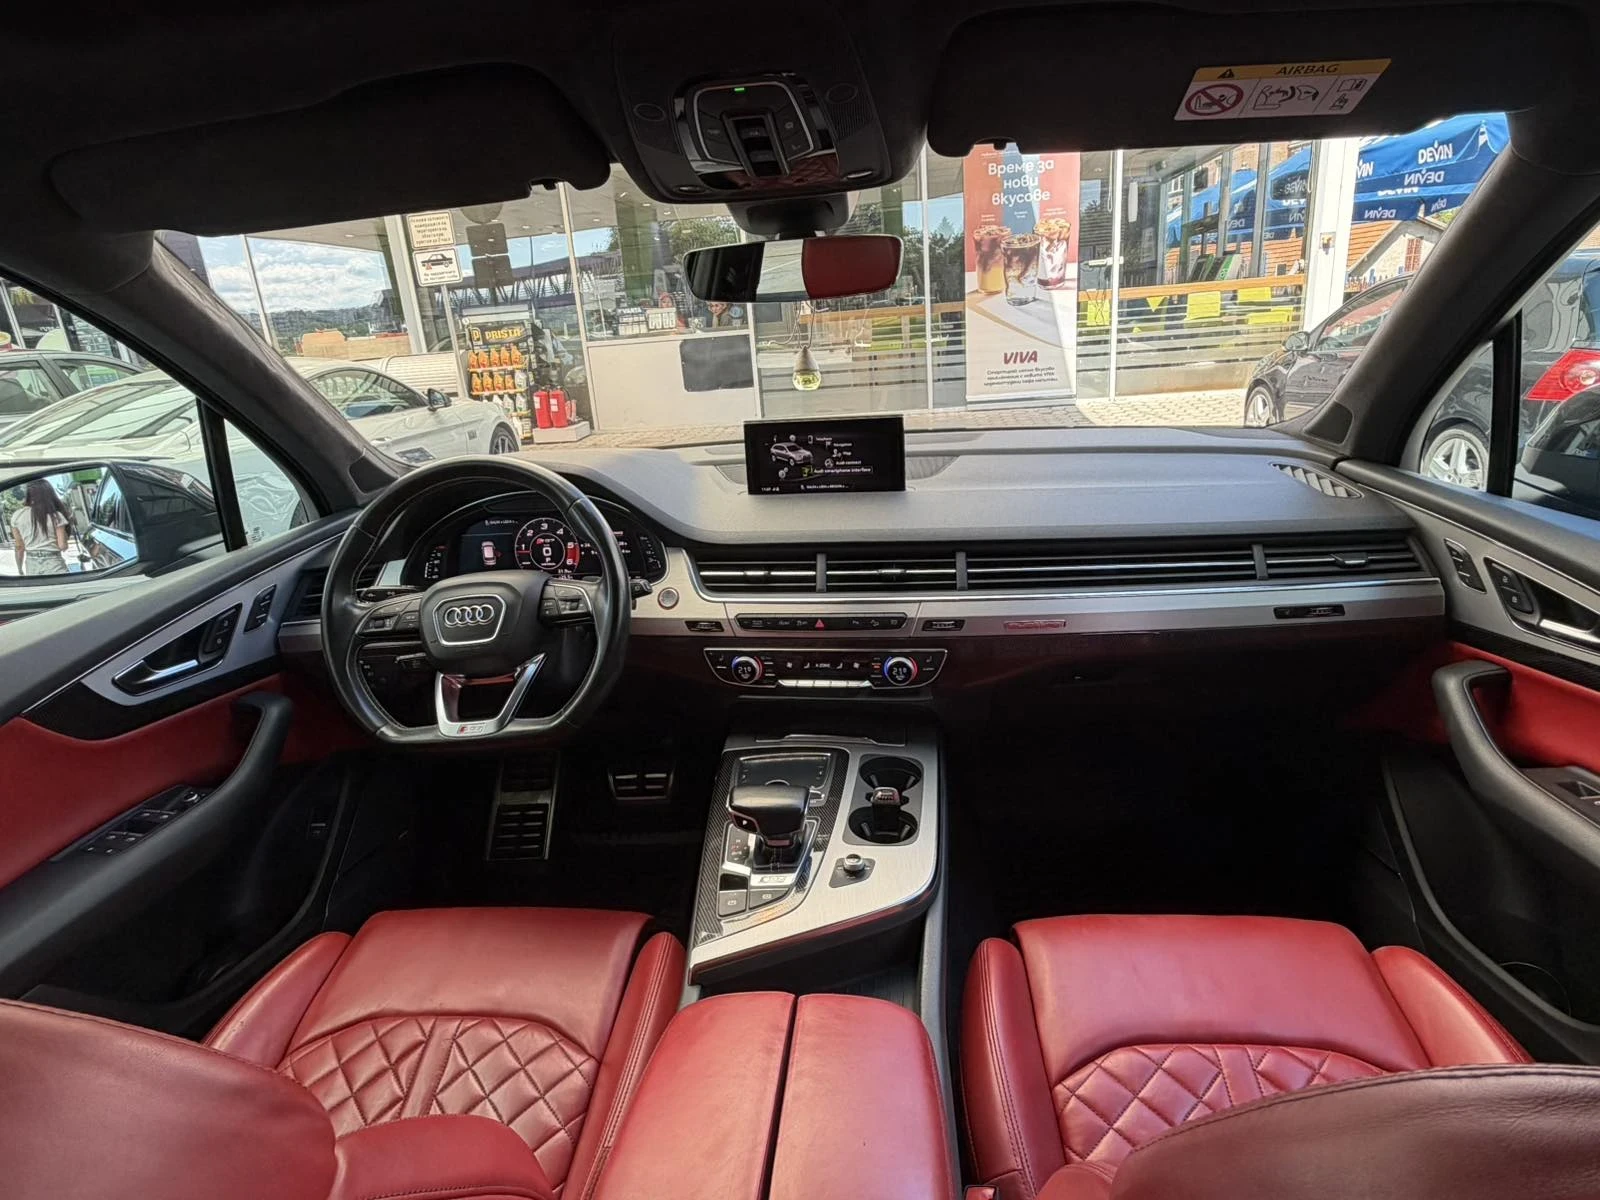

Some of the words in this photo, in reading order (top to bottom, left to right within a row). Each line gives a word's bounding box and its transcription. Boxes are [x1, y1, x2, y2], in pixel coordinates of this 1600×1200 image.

[1276, 63, 1339, 75] AIRBAG
[1418, 140, 1453, 164] DEVIN
[1037, 160, 1054, 173] за
[1356, 159, 1374, 178] VIN
[1003, 174, 1039, 189] нови
[992, 188, 1051, 207] вкусове
[1003, 350, 1038, 364] VIVA
